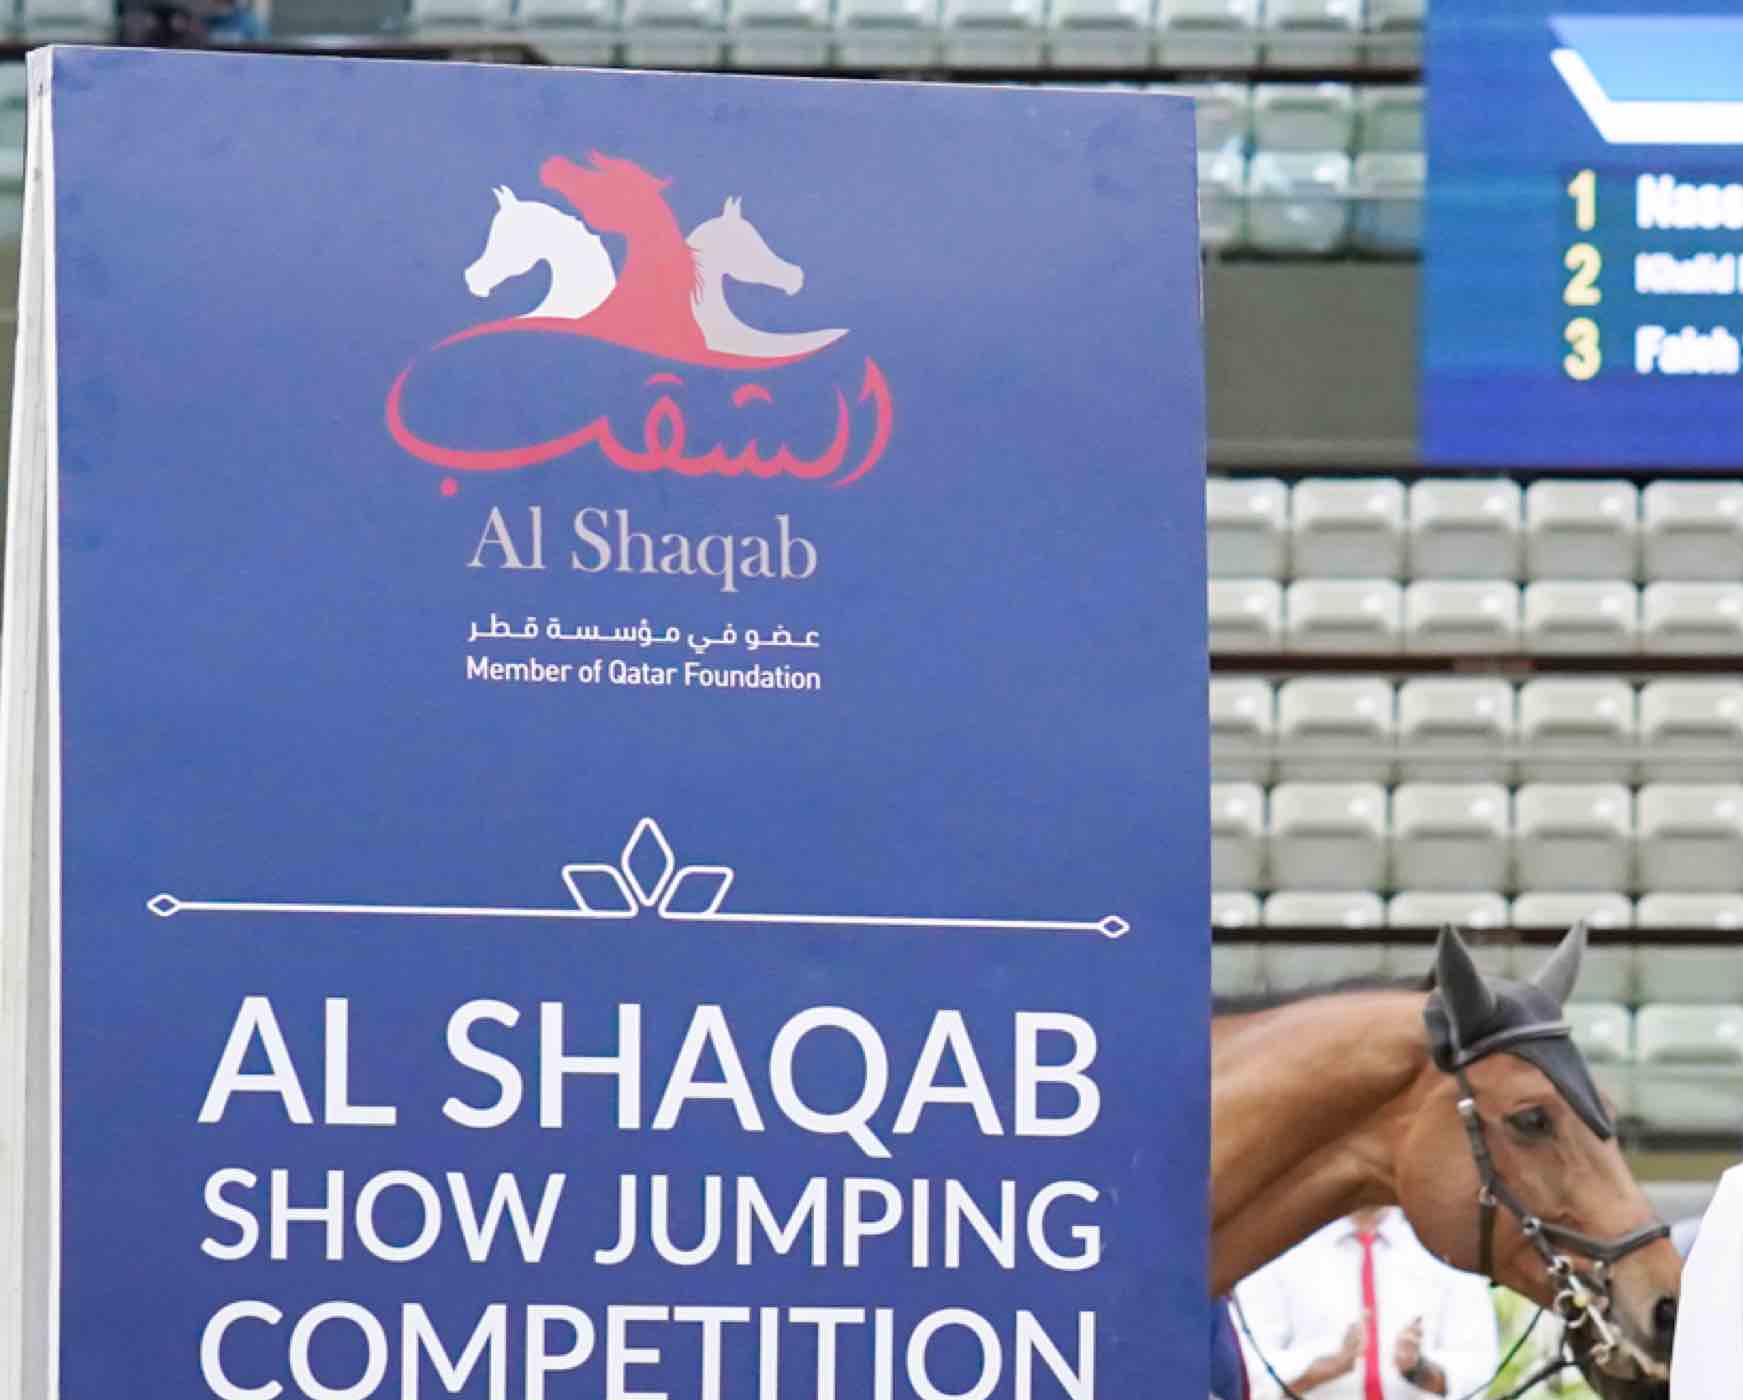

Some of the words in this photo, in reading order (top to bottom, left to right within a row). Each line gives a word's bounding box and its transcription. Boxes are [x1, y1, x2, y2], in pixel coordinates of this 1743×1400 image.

[1567, 168, 1597, 232] 1
[1564, 243, 1602, 306] 2
[1564, 317, 1602, 380] 3
[466, 505, 547, 570] Al
[571, 507, 818, 592] Shaqab
[467, 612, 539, 643] قطر
[546, 616, 680, 648] مؤسسة
[687, 622, 737, 655] في
[744, 623, 820, 650] عضو
[466, 655, 576, 684] Member
[578, 658, 603, 685] of
[608, 659, 677, 688] Qatar
[684, 660, 822, 691] Foundation
[197, 995, 397, 1126] AL
[442, 997, 1102, 1159] SHAQAB
[200, 1167, 566, 1264] SHOW
[594, 1174, 1103, 1272] JUMPING
